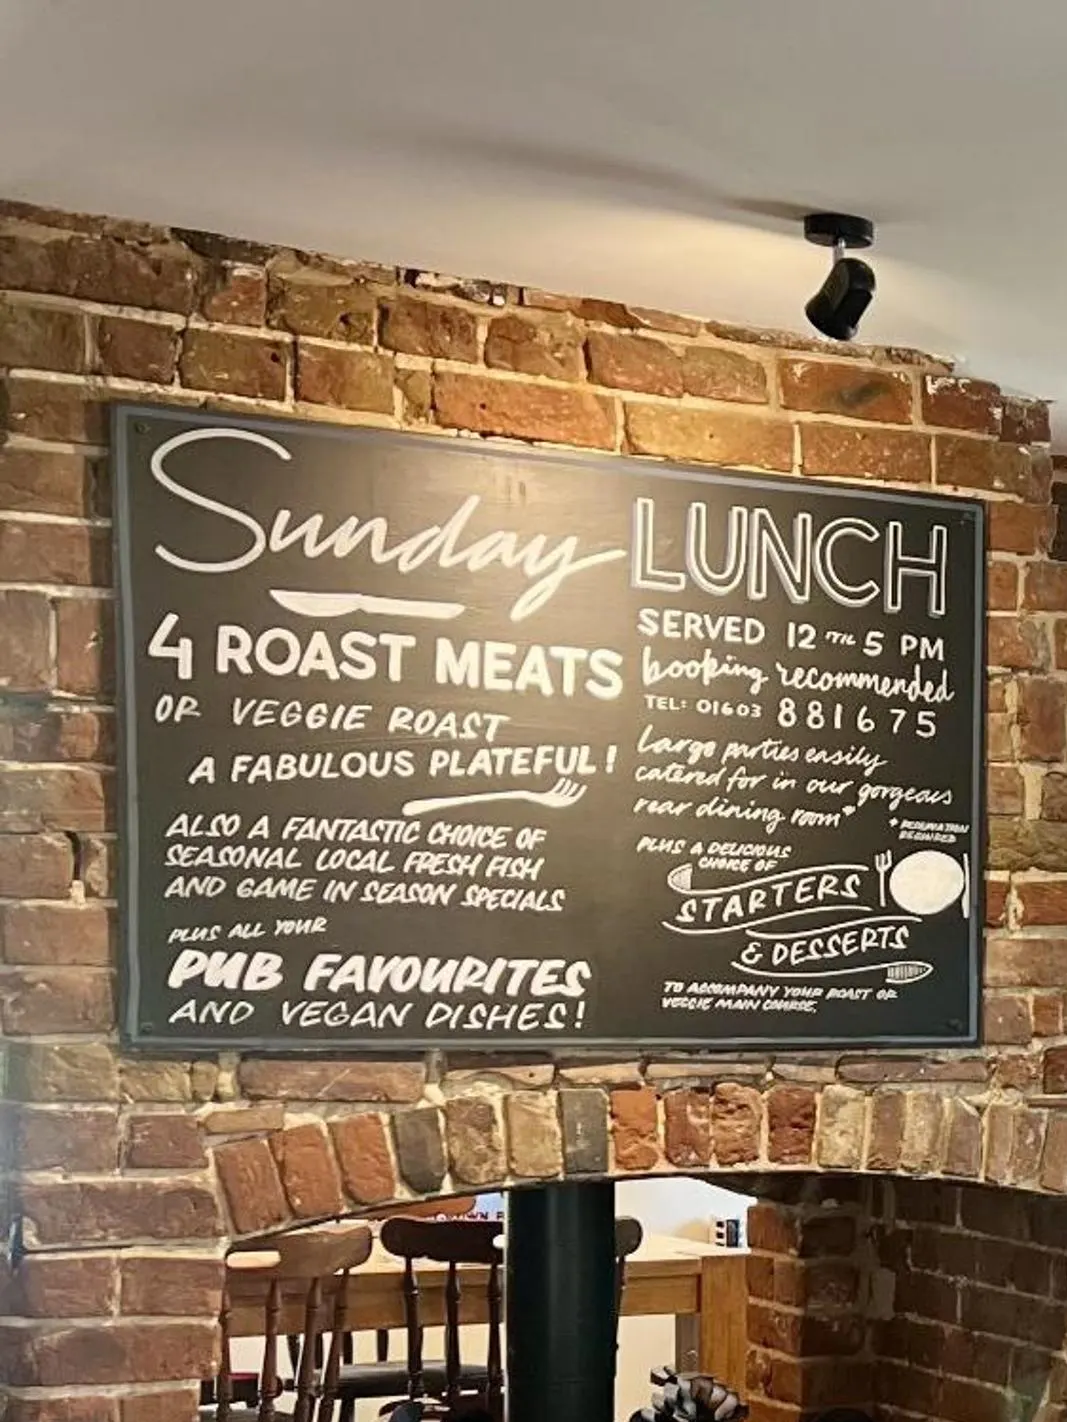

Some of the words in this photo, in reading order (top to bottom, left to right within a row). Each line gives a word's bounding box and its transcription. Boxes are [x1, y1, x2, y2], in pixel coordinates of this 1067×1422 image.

[150, 427, 627, 622] Sunday
[631, 496, 948, 619] LUNCH
[637, 607, 766, 646] SERVED
[787, 622, 817, 650] 12
[862, 630, 885, 657] 5
[900, 635, 945, 662] PM
[147, 612, 193, 680] 4
[215, 625, 416, 682] ROAST
[434, 640, 625, 700] MEATS
[641, 645, 769, 695] booking
[776, 661, 955, 704] recommended
[155, 695, 201, 723] OR
[232, 697, 373, 732] VEGGIE
[388, 706, 511, 743] ROAST
[643, 694, 688, 713] TEL:
[695, 699, 763, 719] 01603
[187, 756, 216, 785] A
[230, 750, 415, 784] FABULOUS
[429, 744, 618, 777] PLATEFUL!
[636, 724, 717, 765] Large
[721, 737, 800, 770] parties
[806, 744, 889, 776] easily
[634, 762, 728, 786] catered
[725, 766, 768, 794] for
[772, 770, 797, 791] in
[805, 778, 855, 795] our
[164, 812, 242, 839] ALSO
[247, 815, 271, 840] A
[282, 816, 421, 845] FANTASTIC
[426, 823, 513, 849] CHOICE
[515, 827, 547, 849] OF
[632, 797, 694, 815] rear
[695, 795, 787, 836] dining
[163, 844, 302, 869] SEASONAL
[315, 848, 396, 873] LOCAL
[402, 851, 483, 877] FRESH
[484, 856, 545, 882] FISH
[635, 835, 687, 855] PLUS
[706, 840, 793, 860] DELICIOUS
[697, 856, 752, 873] CHOICE
[754, 858, 779, 872] OF
[164, 875, 227, 900] AND
[236, 879, 319, 901] GAME
[322, 879, 359, 902] IN
[360, 881, 458, 907] SEASON
[459, 884, 567, 912] SPECIALS
[674, 872, 862, 925] STARTERS
[167, 925, 222, 944] PLUS
[228, 920, 266, 939] ALL
[273, 916, 328, 938] YOUR
[740, 941, 764, 965] &
[772, 925, 911, 966] DESSERTS
[167, 948, 284, 992] PUB
[303, 953, 592, 998] FAVOURITES
[663, 981, 685, 994] TO
[782, 985, 825, 999] YOUR
[825, 988, 874, 1000] ROAST
[876, 988, 899, 1000] OR
[168, 998, 255, 1025] AND
[280, 1000, 413, 1029] VEGAN
[425, 1001, 586, 1031] DISHES!
[714, 998, 761, 1012] MAIN
